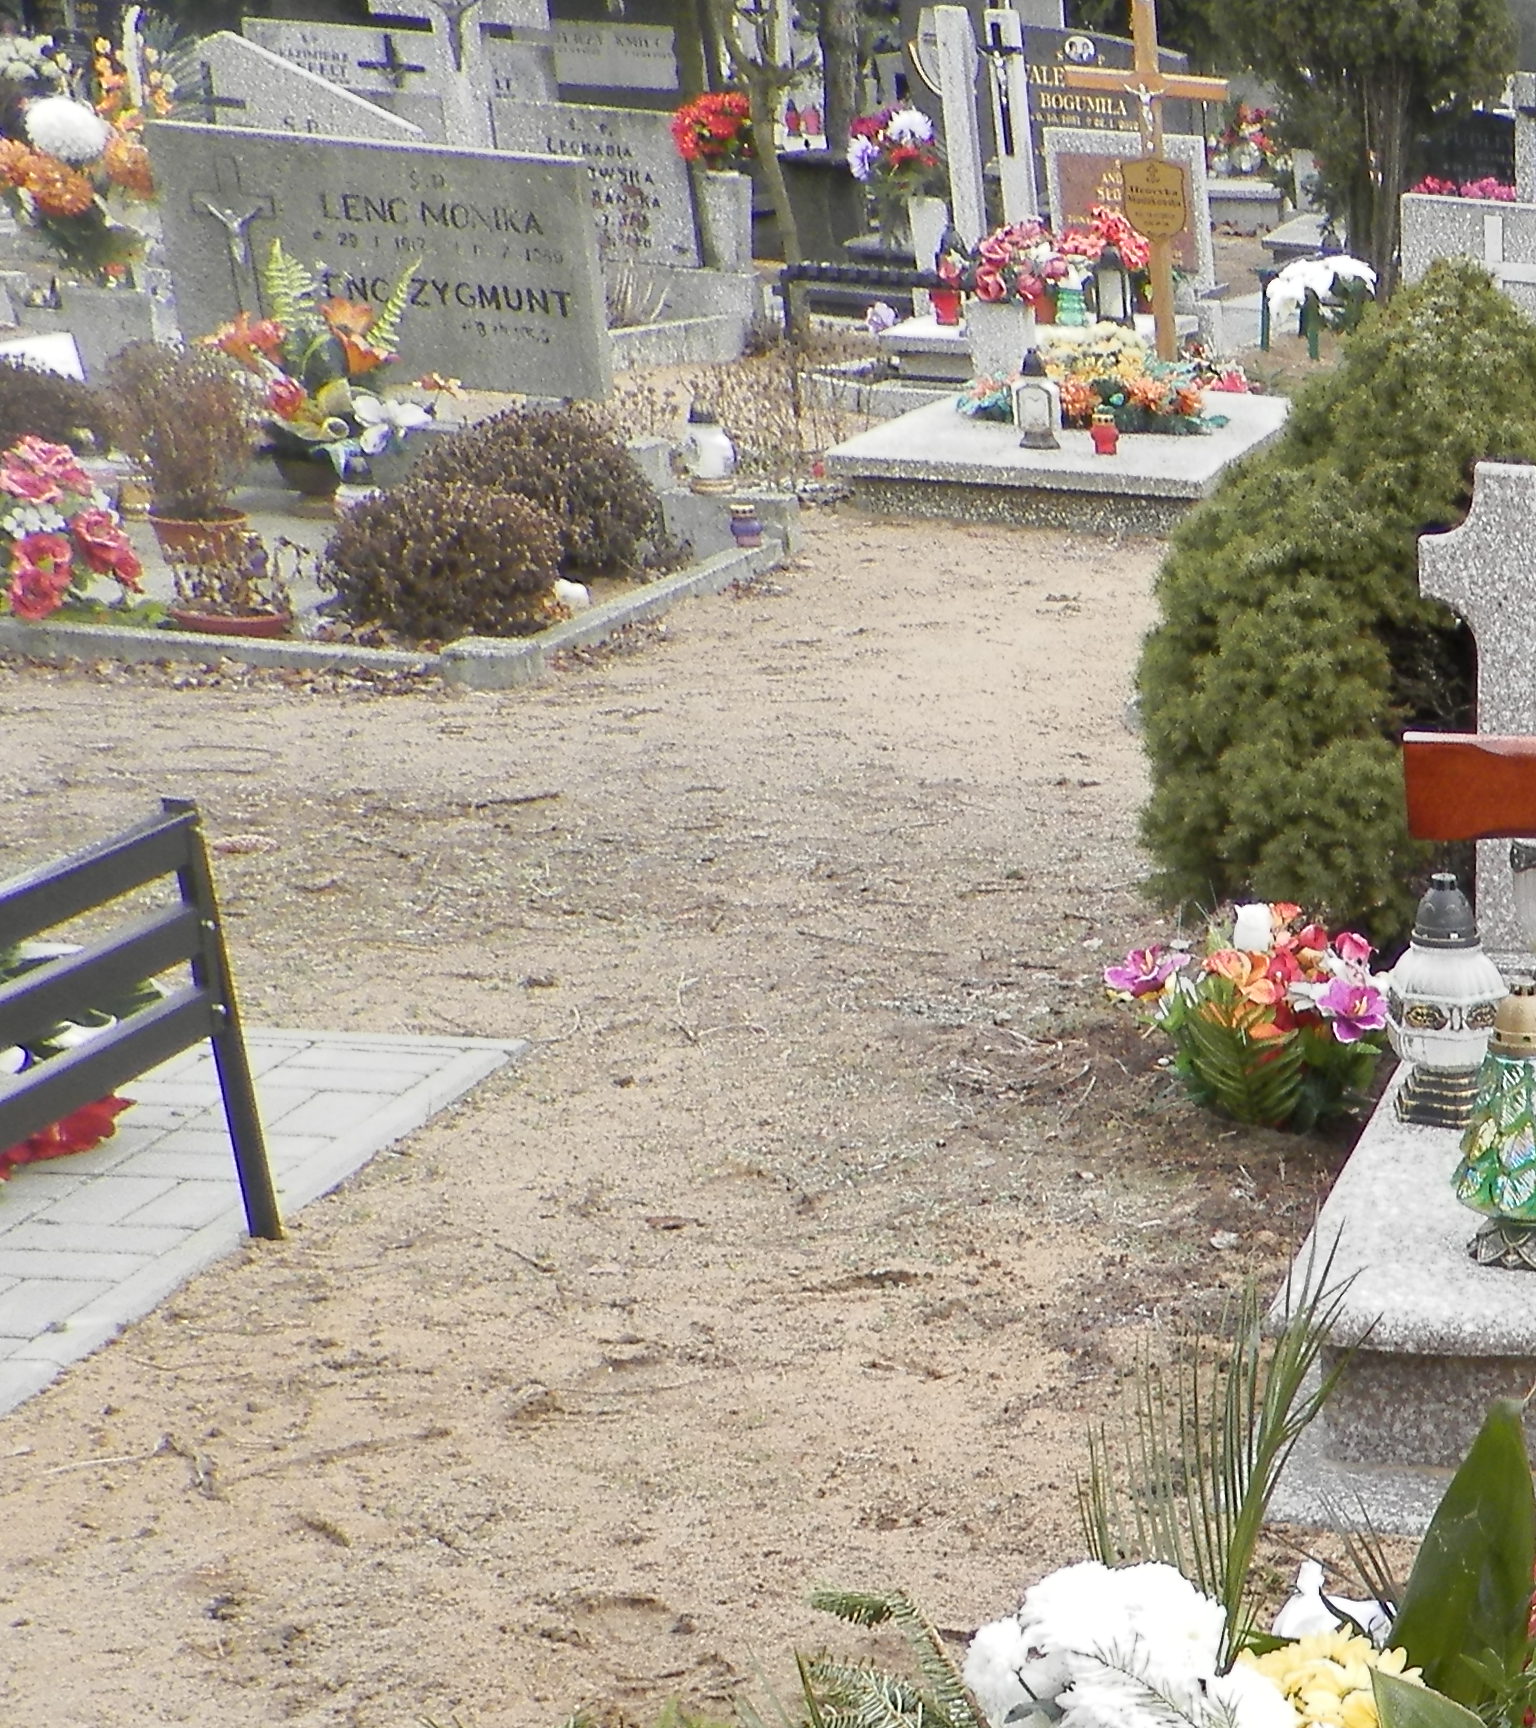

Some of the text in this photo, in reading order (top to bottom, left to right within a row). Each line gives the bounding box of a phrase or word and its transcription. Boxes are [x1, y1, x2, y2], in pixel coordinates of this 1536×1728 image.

[319, 192, 544, 235] LENC MONIKA
[322, 271, 571, 318] ENC ZYGMUNT
